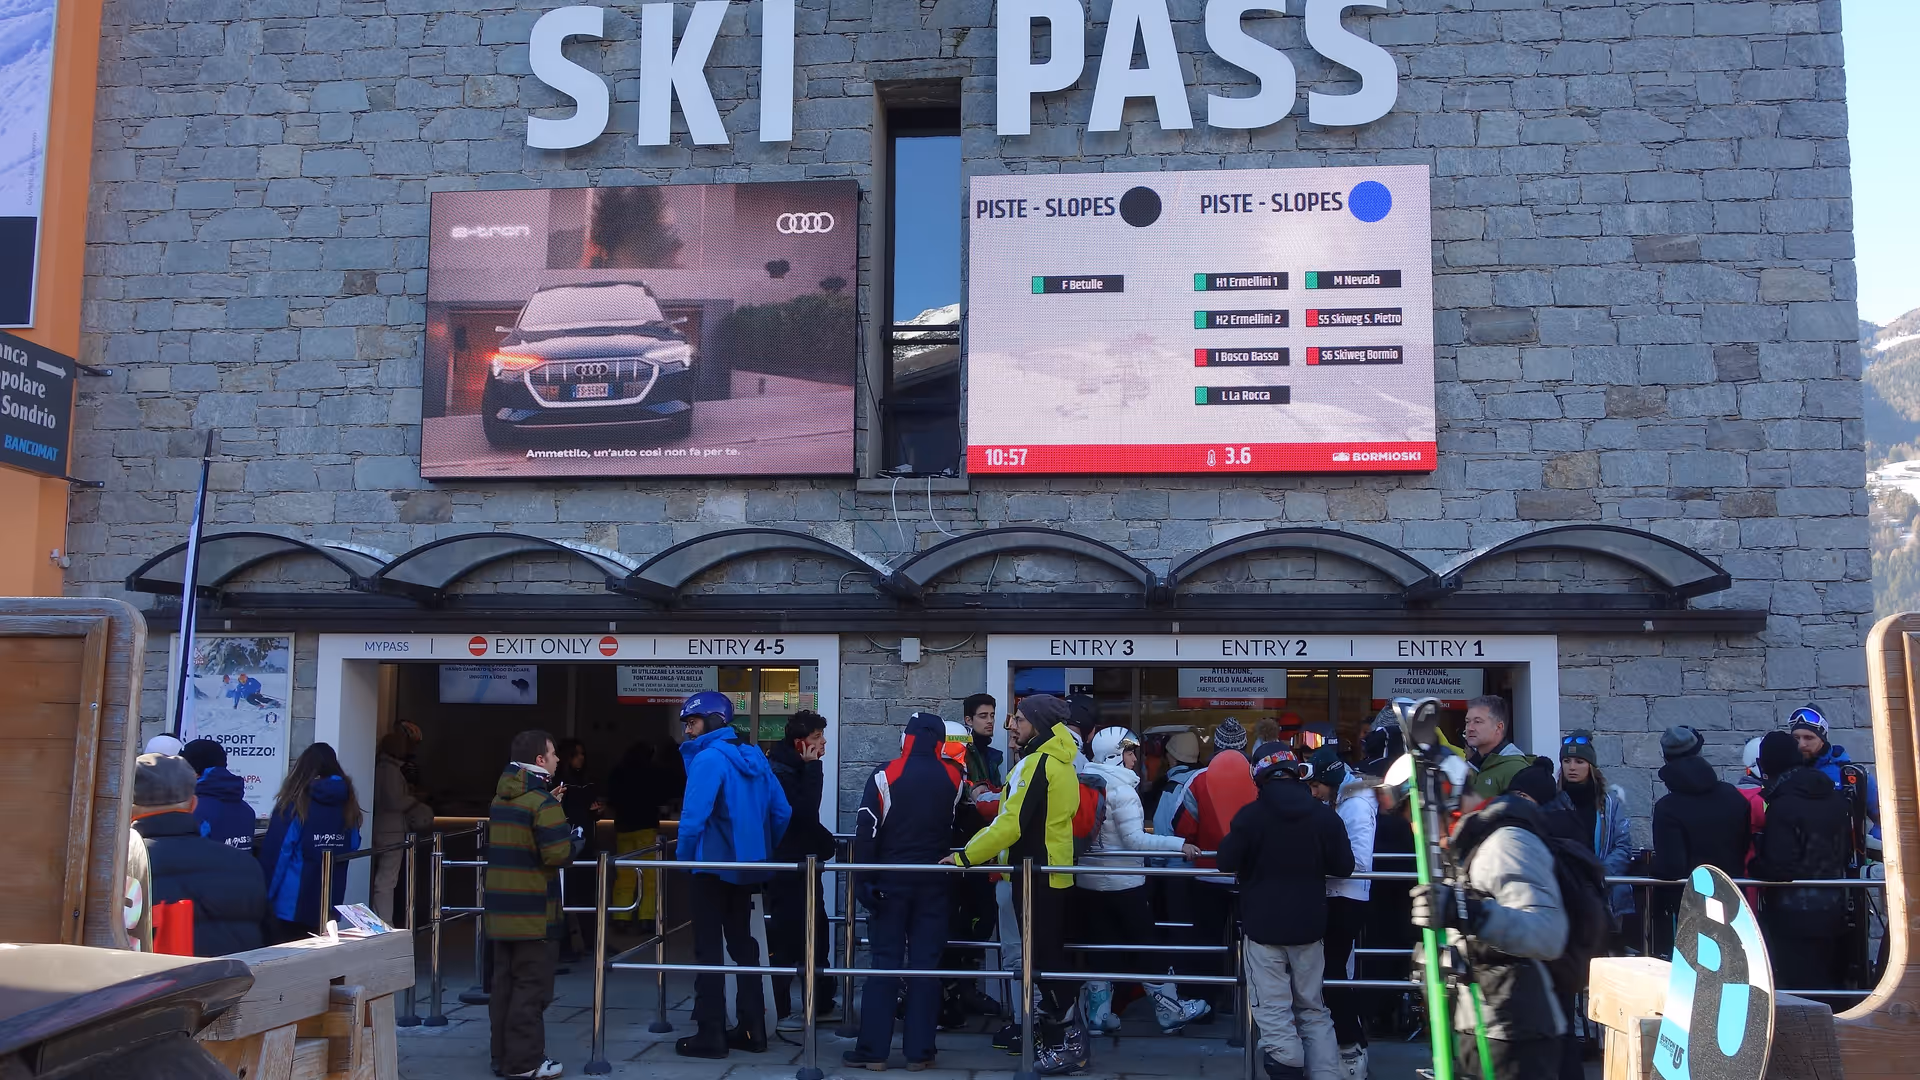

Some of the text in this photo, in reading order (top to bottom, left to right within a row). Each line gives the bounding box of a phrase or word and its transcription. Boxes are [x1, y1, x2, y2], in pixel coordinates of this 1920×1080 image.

[527, 0, 1399, 150] SKI PASS
[976, 199, 1028, 219] PISTE
[1045, 197, 1115, 218] SLOPES
[1200, 193, 1253, 214] PISTE
[1272, 192, 1343, 213] SLOPES
[1062, 279, 1103, 291] F Betulle
[1216, 276, 1278, 288] H1 Ermellini 1
[1333, 274, 1380, 285] M Nevada
[1216, 314, 1281, 325] H2 Ermellini 2
[1318, 312, 1401, 326] S5 Skiweg S. Pietro
[0, 342, 28, 367] nca
[1221, 351, 1249, 361] Bosco
[1251, 350, 1279, 361] Basso
[1321, 348, 1399, 362] S6 Skiweg Bormio
[0, 370, 46, 399] polare
[1222, 390, 1270, 401] L La Rocca
[1, 395, 56, 429] Sondrio
[4, 434, 59, 461] BANCOMAT
[526, 447, 740, 458] Ammettilo, un'auto così non fa per te.
[985, 447, 1028, 466] 10:57
[1225, 447, 1252, 465] 3.6
[1352, 451, 1421, 462] BORMIOSKI
[364, 641, 409, 652] MYPASS
[495, 638, 591, 654] EXIT ONLY
[688, 639, 785, 654] ENTRY 4-5
[1051, 640, 1134, 656] ENTRY 3
[1222, 640, 1307, 656] ENTRY 2
[1398, 640, 1484, 656] ENTRY 1
[1200, 676, 1265, 684] PERICOLO VALANGHE
[216, 735, 255, 744] SPORT
[226, 747, 275, 756] PREZZO!
